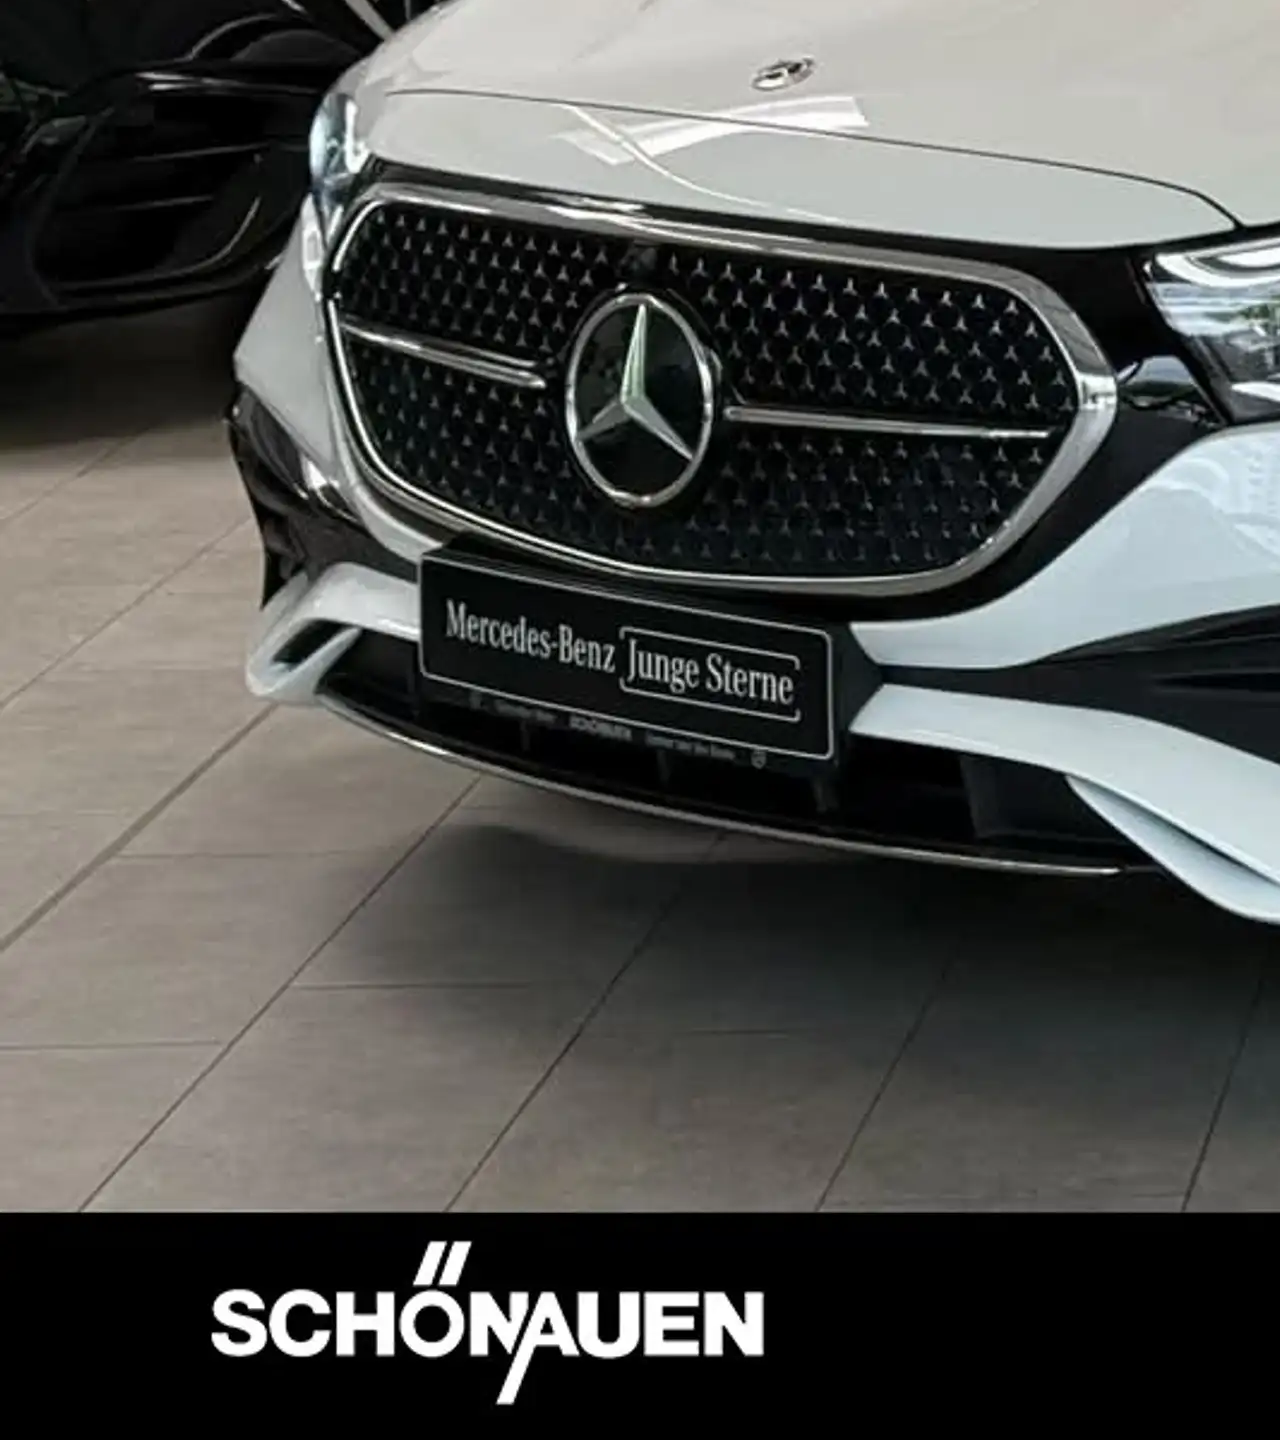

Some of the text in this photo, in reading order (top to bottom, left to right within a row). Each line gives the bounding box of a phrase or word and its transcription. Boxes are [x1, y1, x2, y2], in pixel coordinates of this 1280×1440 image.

[445, 600, 794, 705] Mercedes-Benz Junge Sterne
